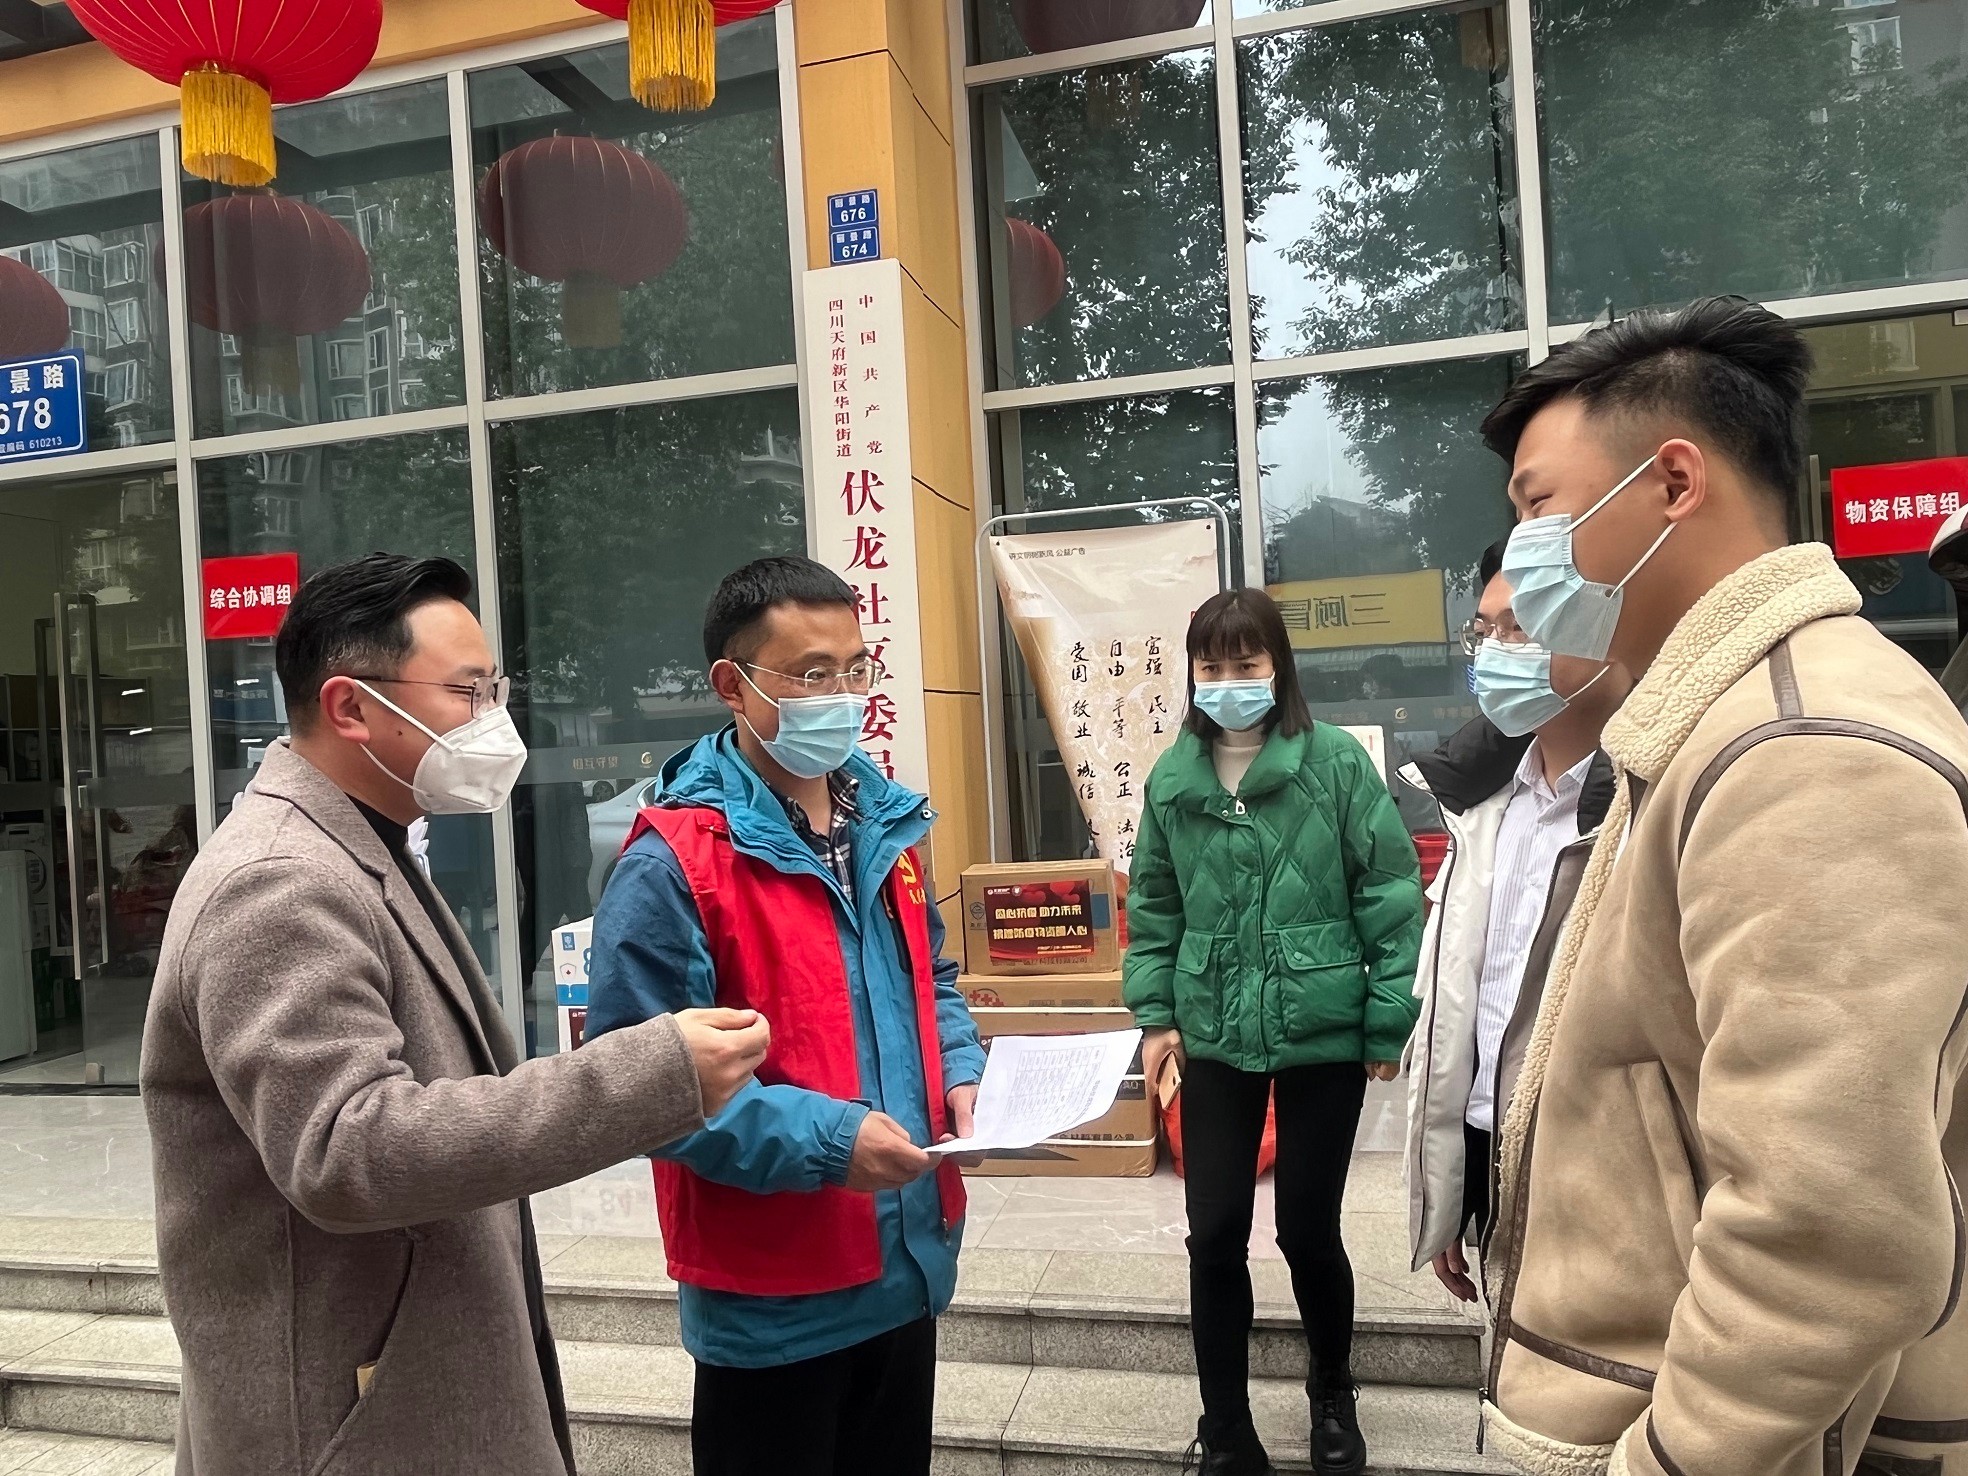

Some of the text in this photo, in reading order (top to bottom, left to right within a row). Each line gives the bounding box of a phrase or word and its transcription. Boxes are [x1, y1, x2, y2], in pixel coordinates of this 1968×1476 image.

[841, 207, 866, 222] 676
[842, 242, 868, 258] 674
[828, 298, 852, 458] 四川天府新区华阳街道
[858, 294, 883, 454] 中国共产党
[0, 397, 51, 435] 678
[29, 436, 62, 449] 610213
[1845, 491, 1960, 524] 物资保障组
[210, 584, 291, 609] 综合协调组
[1108, 639, 1125, 676] 自由
[1145, 635, 1167, 734] 富强 民主
[1112, 696, 1127, 738] 平等
[1114, 761, 1132, 798] 公正
